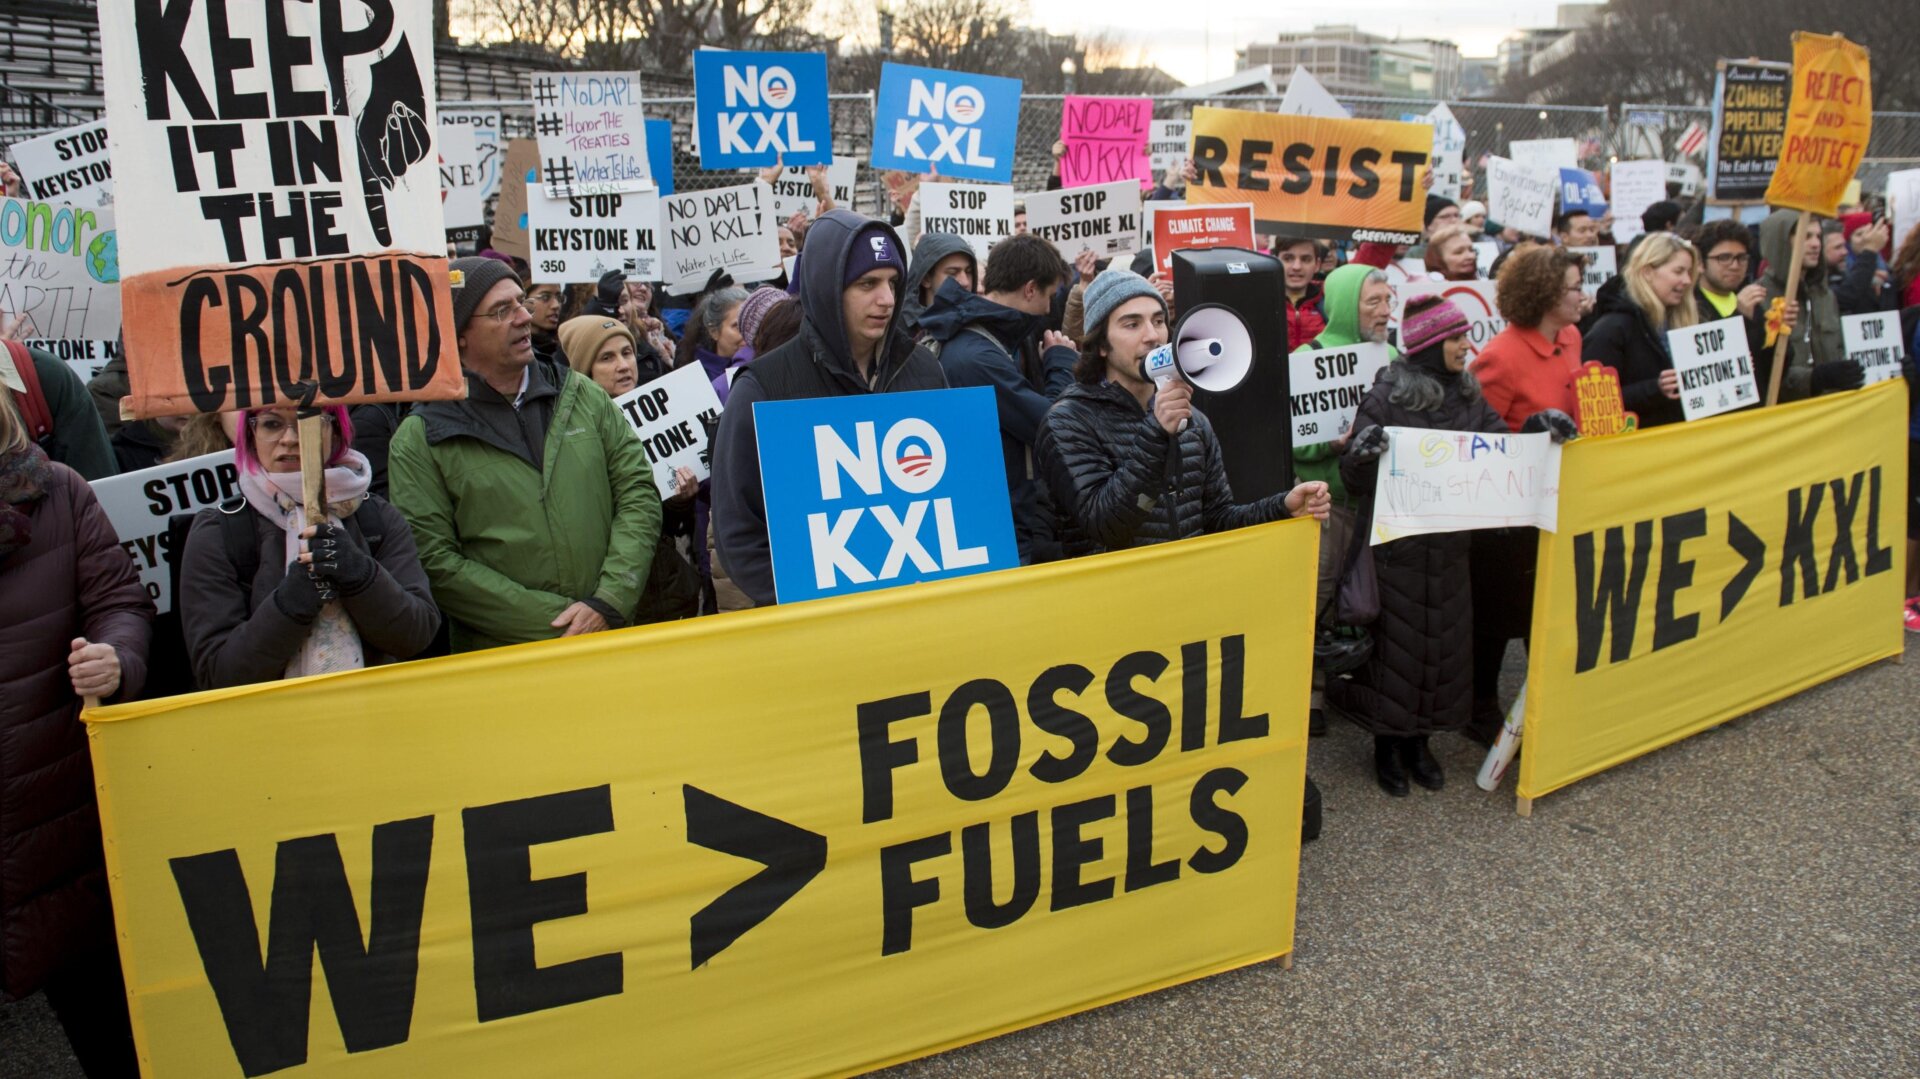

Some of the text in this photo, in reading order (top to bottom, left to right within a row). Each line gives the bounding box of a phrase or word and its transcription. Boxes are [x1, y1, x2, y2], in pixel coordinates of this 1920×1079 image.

[135, 0, 394, 120] KEEP
[724, 65, 796, 109] NO
[907, 79, 985, 125] NO
[1725, 84, 1784, 108] ZOMBIE
[1805, 70, 1864, 106] REJECT
[717, 112, 816, 154] KXL
[1165, 125, 1185, 136] STOP
[1724, 111, 1784, 132] PIPELINE
[1815, 111, 1844, 128] AND
[54, 127, 108, 161] STOP
[167, 120, 342, 192] IT IN
[565, 132, 630, 151] TREATIES
[894, 119, 995, 169] KXL
[1720, 134, 1783, 157] SLAYER
[1786, 135, 1861, 171] PROTECT
[32, 158, 112, 200] KEYSTON
[1064, 142, 1092, 183] NO
[1190, 135, 1427, 201] RESIST
[569, 194, 622, 217] STOP
[668, 198, 697, 222] NO
[834, 186, 848, 201] XL
[949, 190, 986, 209] STOP
[1060, 191, 1106, 215] STOP
[0, 199, 97, 256] onor
[200, 191, 349, 262] THE
[535, 228, 656, 251] KEYSTONE XL
[671, 224, 700, 249] NO
[925, 217, 1011, 235] KEYSTONE XL
[1118, 214, 1136, 232] XL
[1168, 216, 1236, 235] CLIMATE CHANGE
[1352, 229, 1420, 244] GREENPEACE
[0, 252, 59, 280] the
[676, 256, 706, 274] Water
[722, 248, 750, 264] Life
[0, 283, 92, 338] ARTH
[181, 259, 441, 413] GROUND
[1694, 328, 1724, 355] STOP
[1861, 319, 1883, 340] STOP
[1314, 352, 1358, 380] STOP
[1681, 356, 1750, 391] KEYSTONE XL
[1582, 381, 1617, 398] NO OIL
[620, 388, 669, 428] TOP
[1582, 399, 1620, 418] IN OUR
[642, 420, 698, 464] TONE
[1590, 418, 1616, 436] SOIL
[813, 418, 947, 499] NO
[143, 463, 237, 516] STOP
[322, 521, 338, 570] WANT
[807, 497, 989, 589] KXL
[1574, 507, 1708, 674] WE
[1780, 465, 1893, 607] KXL
[856, 634, 1270, 823] FOSSIL
[880, 767, 1249, 957] FUELS
[170, 784, 624, 1078] WE
